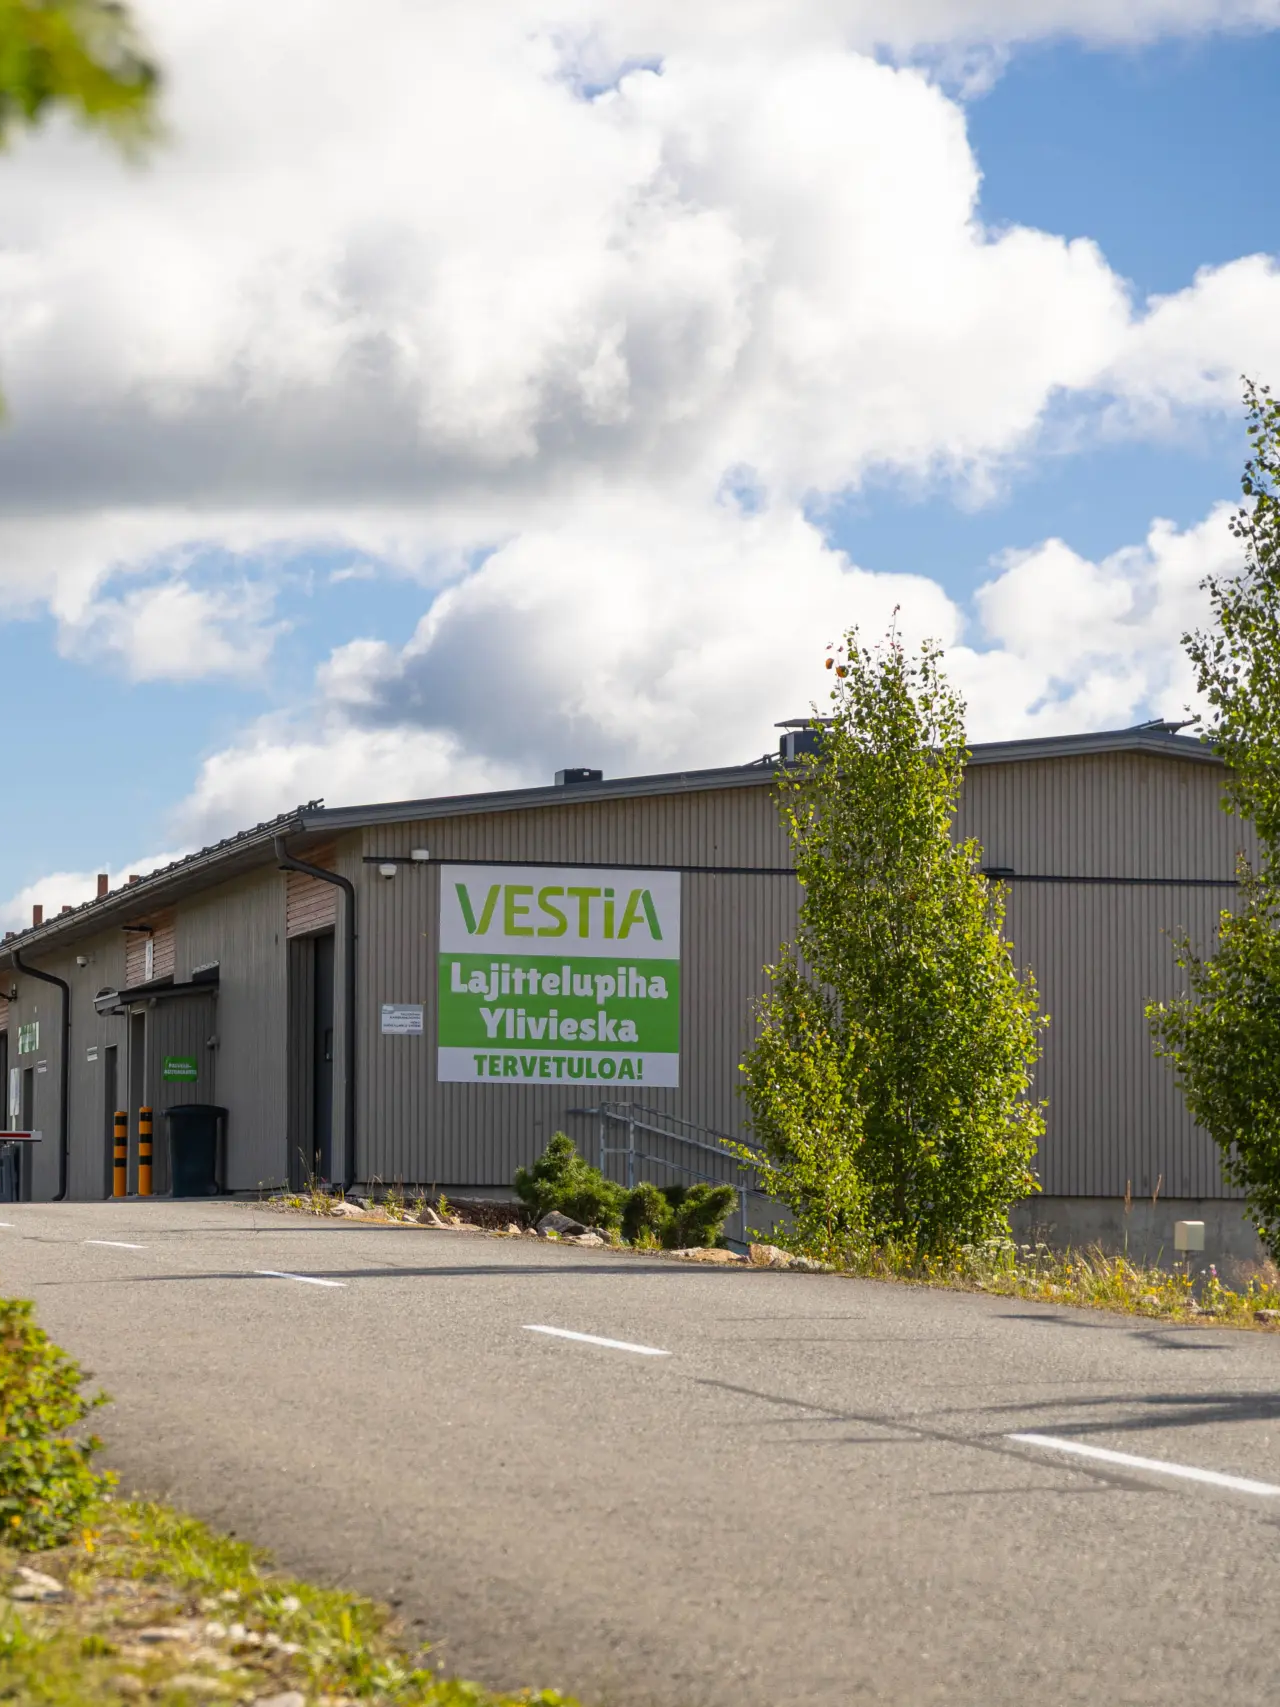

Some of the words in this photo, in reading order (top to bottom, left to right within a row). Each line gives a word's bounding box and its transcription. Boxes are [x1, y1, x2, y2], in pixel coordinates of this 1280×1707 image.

[451, 962, 669, 1005] Lajittelupiha
[479, 1007, 639, 1042] Ylivieska
[474, 1054, 643, 1080] TERVETULOA!
